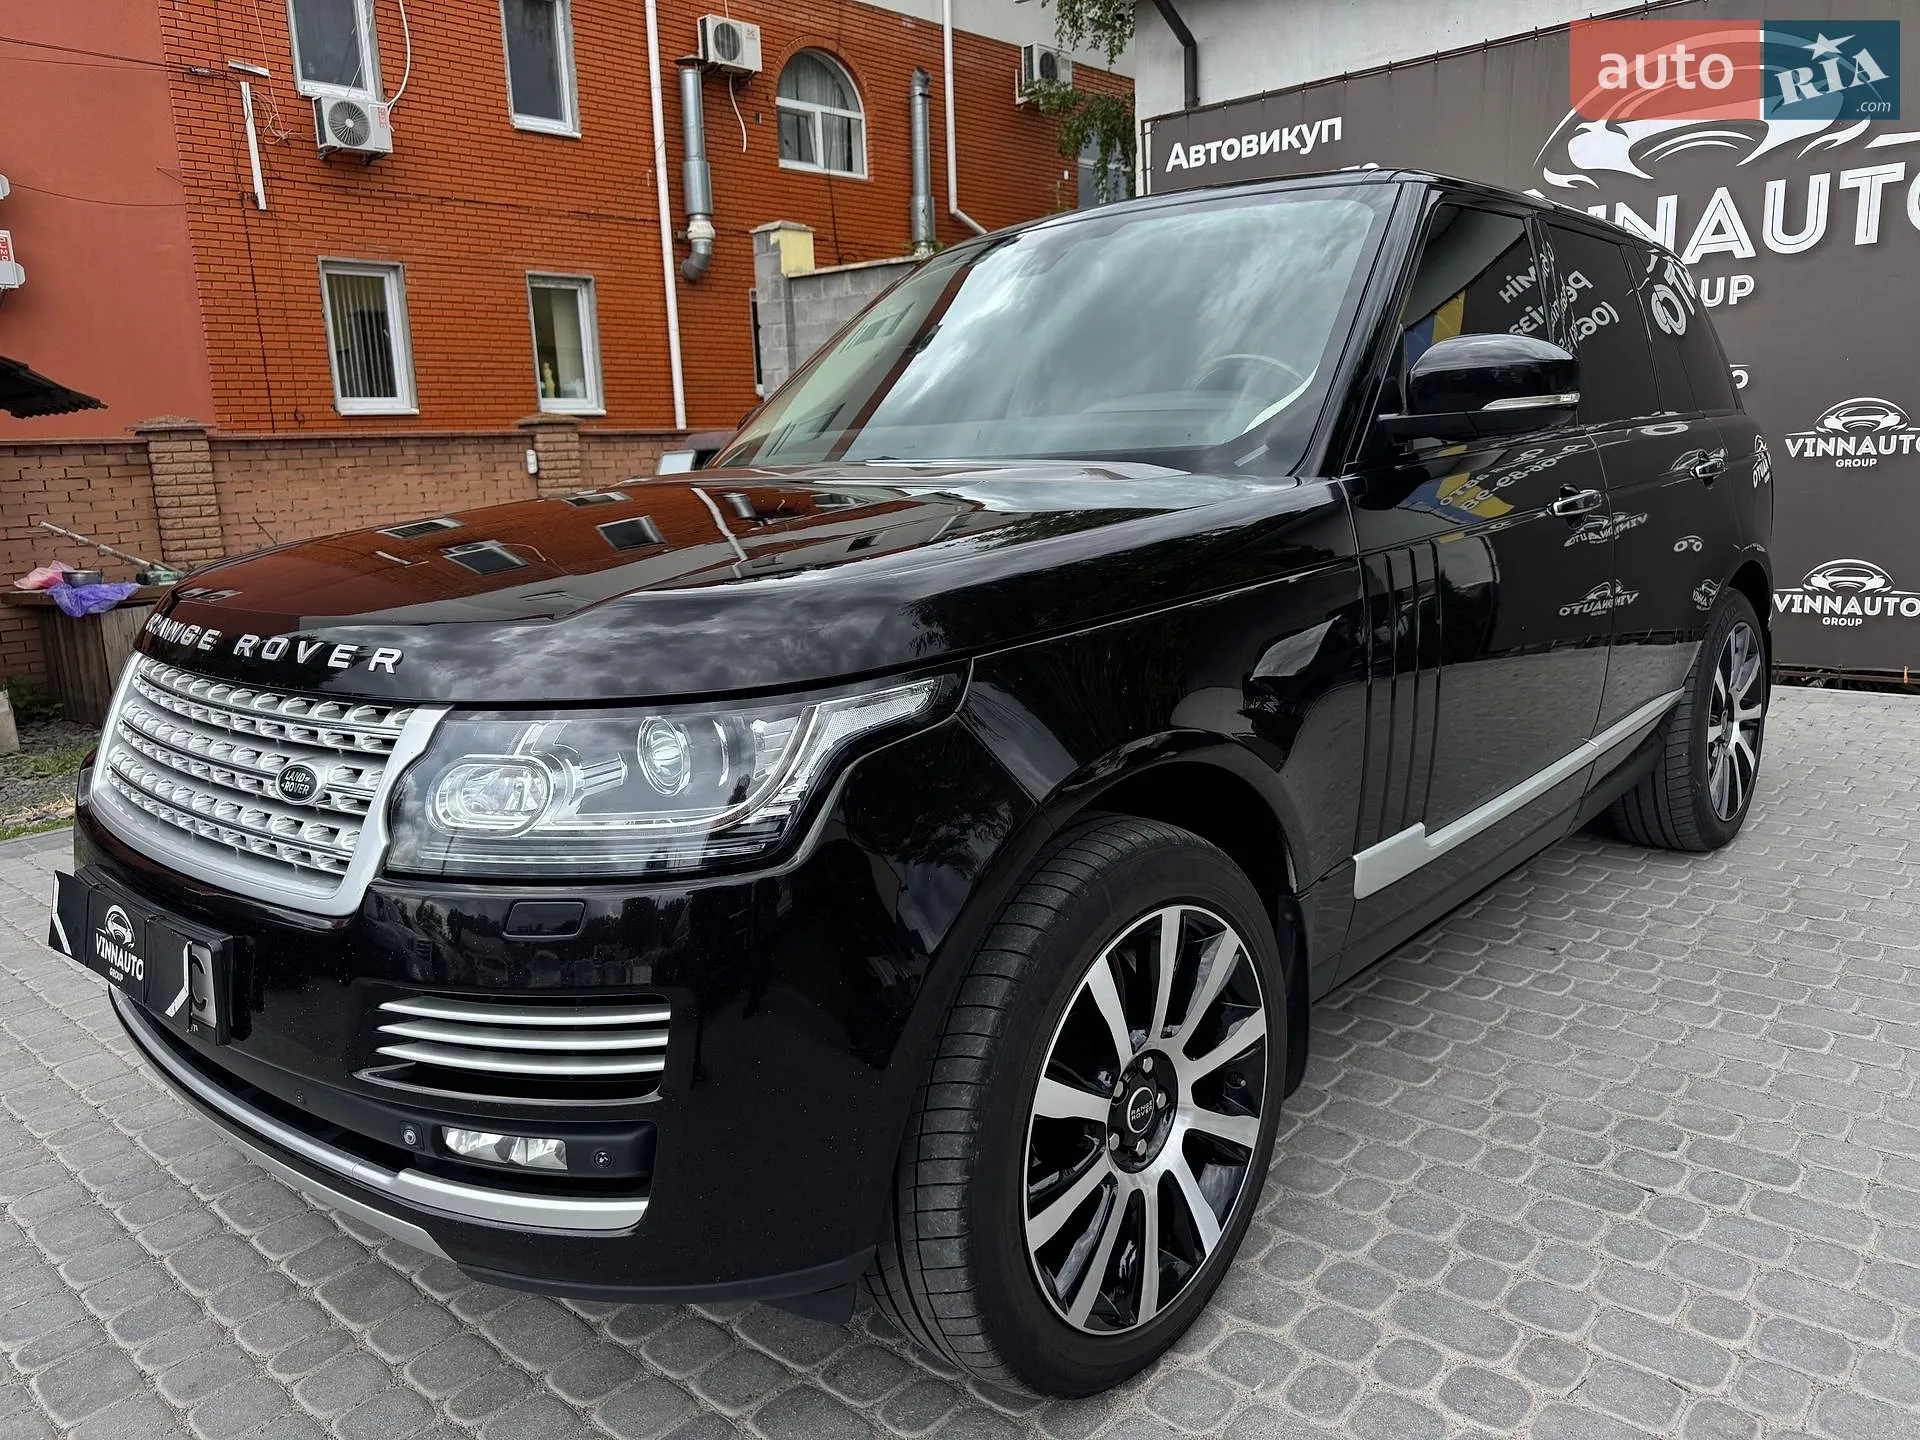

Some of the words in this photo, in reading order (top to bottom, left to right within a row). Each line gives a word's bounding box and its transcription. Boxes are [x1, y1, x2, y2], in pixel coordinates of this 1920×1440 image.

[1165, 116, 1343, 173] Автовикуп
[1785, 434, 1920, 457] VINNAUT
[1836, 459, 1877, 468] GROUP
[1773, 593, 1920, 617] VINNAUTO
[1822, 617, 1863, 627] GROUP
[145, 613, 222, 651] RANGE
[233, 633, 402, 674] ROVER
[285, 770, 306, 782] LAND
[283, 781, 310, 795] ROVER
[96, 932, 144, 981] VINNAUTO
